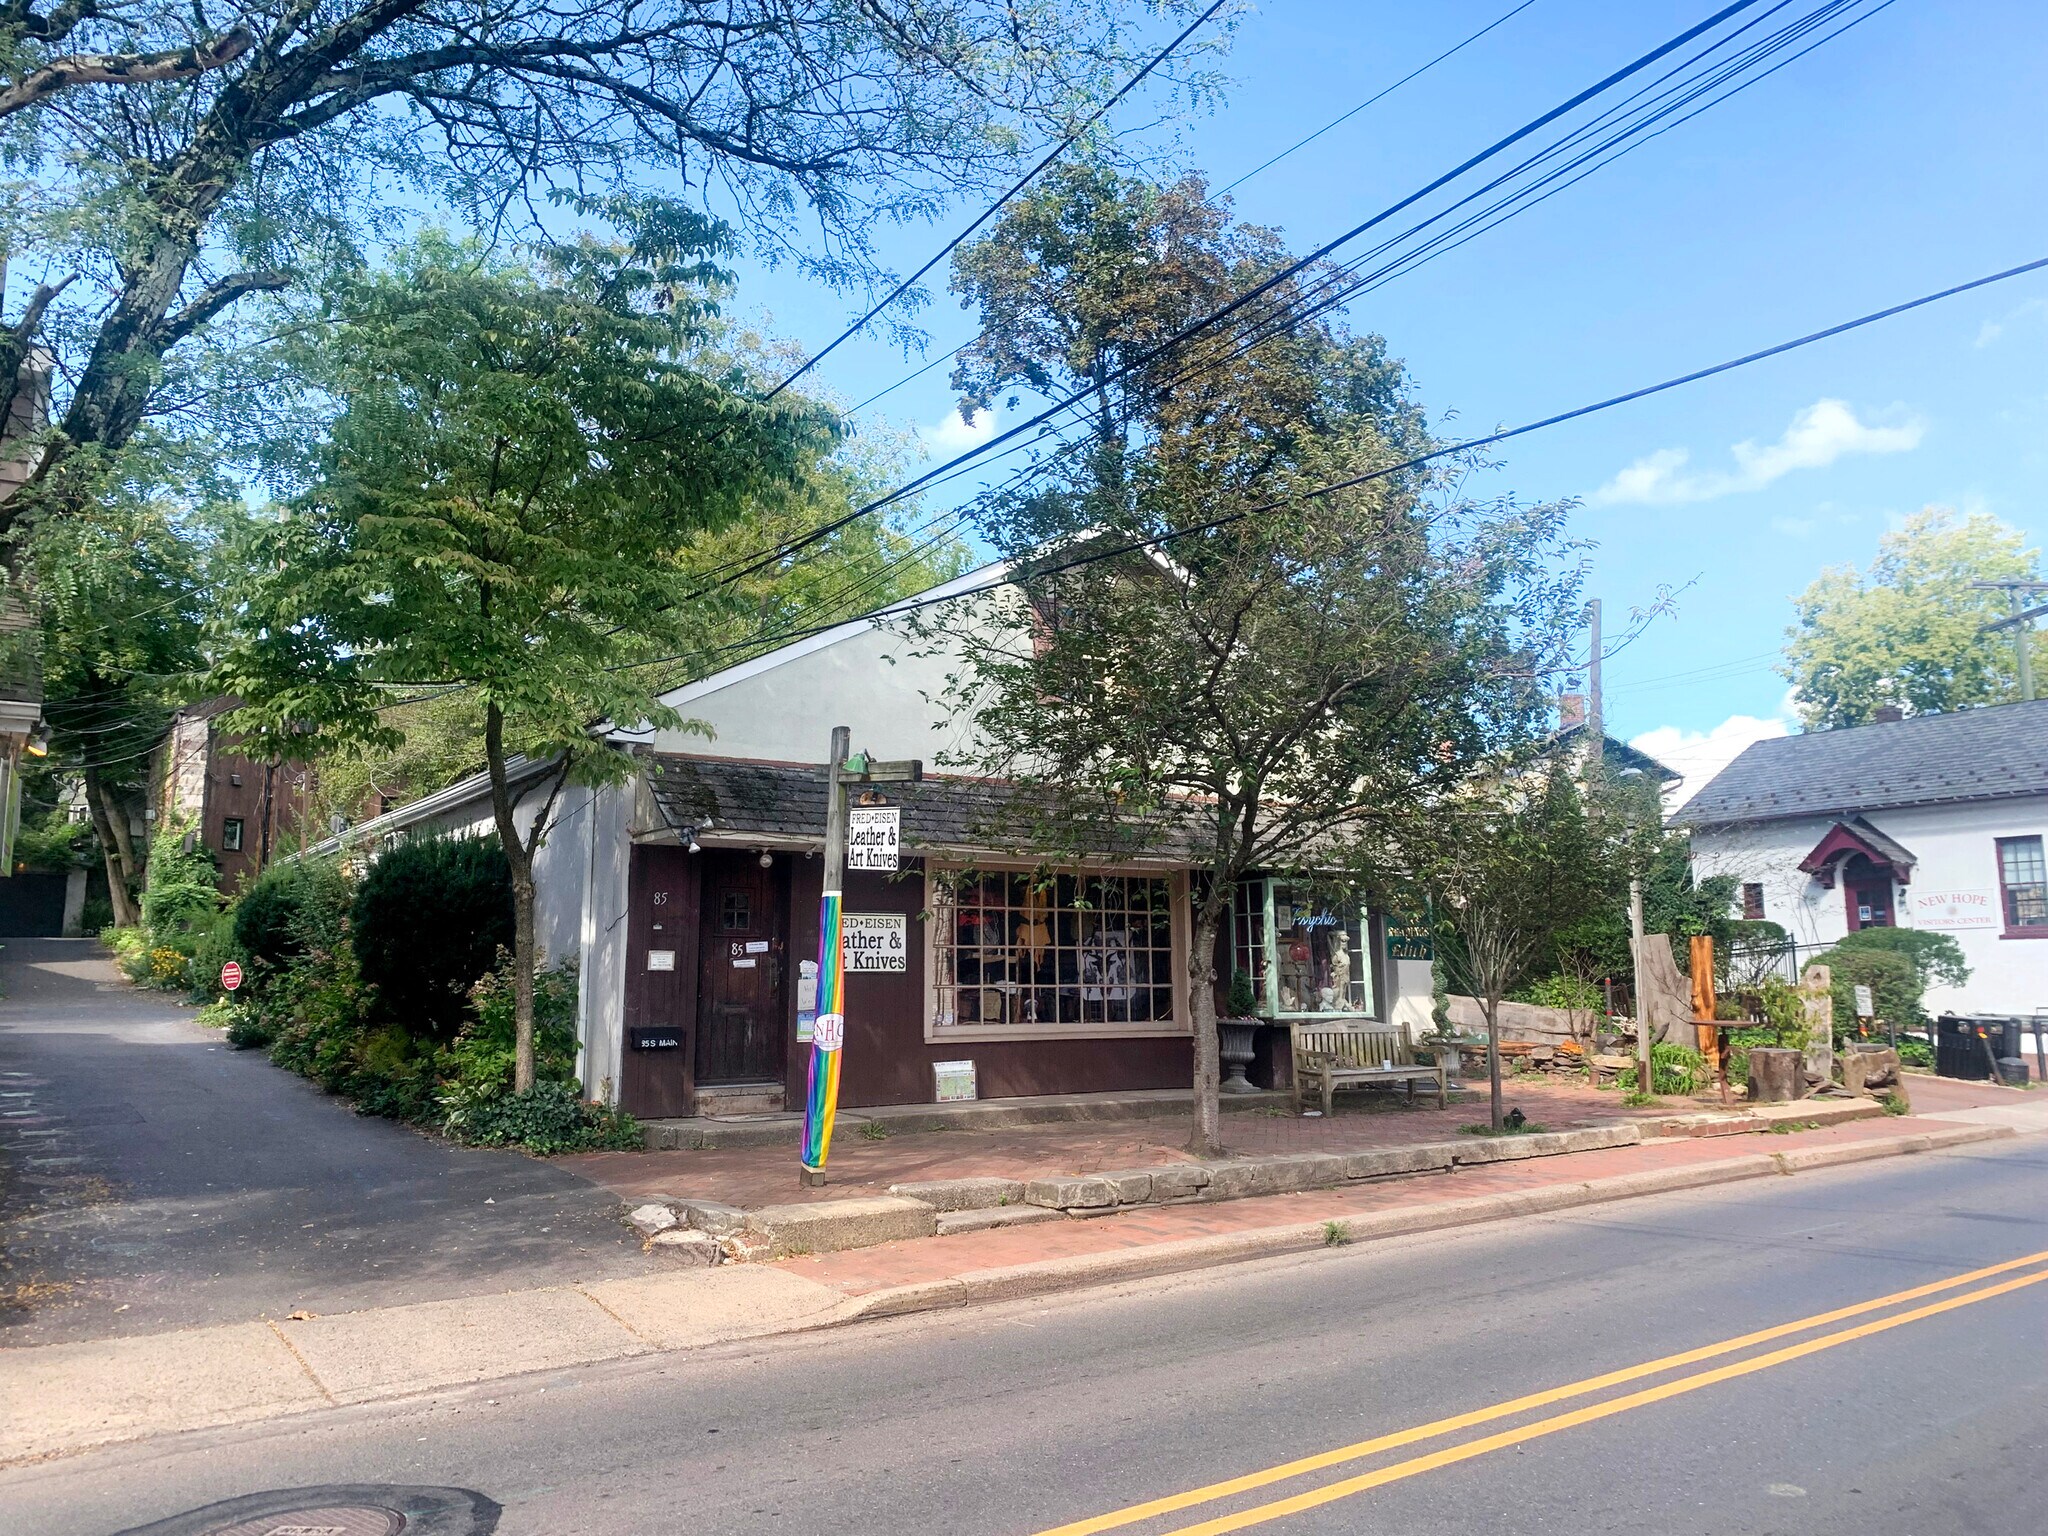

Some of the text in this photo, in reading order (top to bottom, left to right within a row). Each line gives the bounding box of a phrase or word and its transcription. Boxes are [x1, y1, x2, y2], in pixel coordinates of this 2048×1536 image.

[849, 826, 897, 846] Leather &
[848, 848, 898, 868] Art Knives
[653, 891, 669, 905] 85
[1917, 893, 1989, 909] NEW HOPE
[842, 917, 902, 929] ED EISEN
[1956, 917, 1992, 925] CENTER
[842, 930, 902, 949] ather &
[731, 942, 744, 957] 85
[853, 951, 906, 970] Knives
[658, 1039, 678, 1047] MAIN
